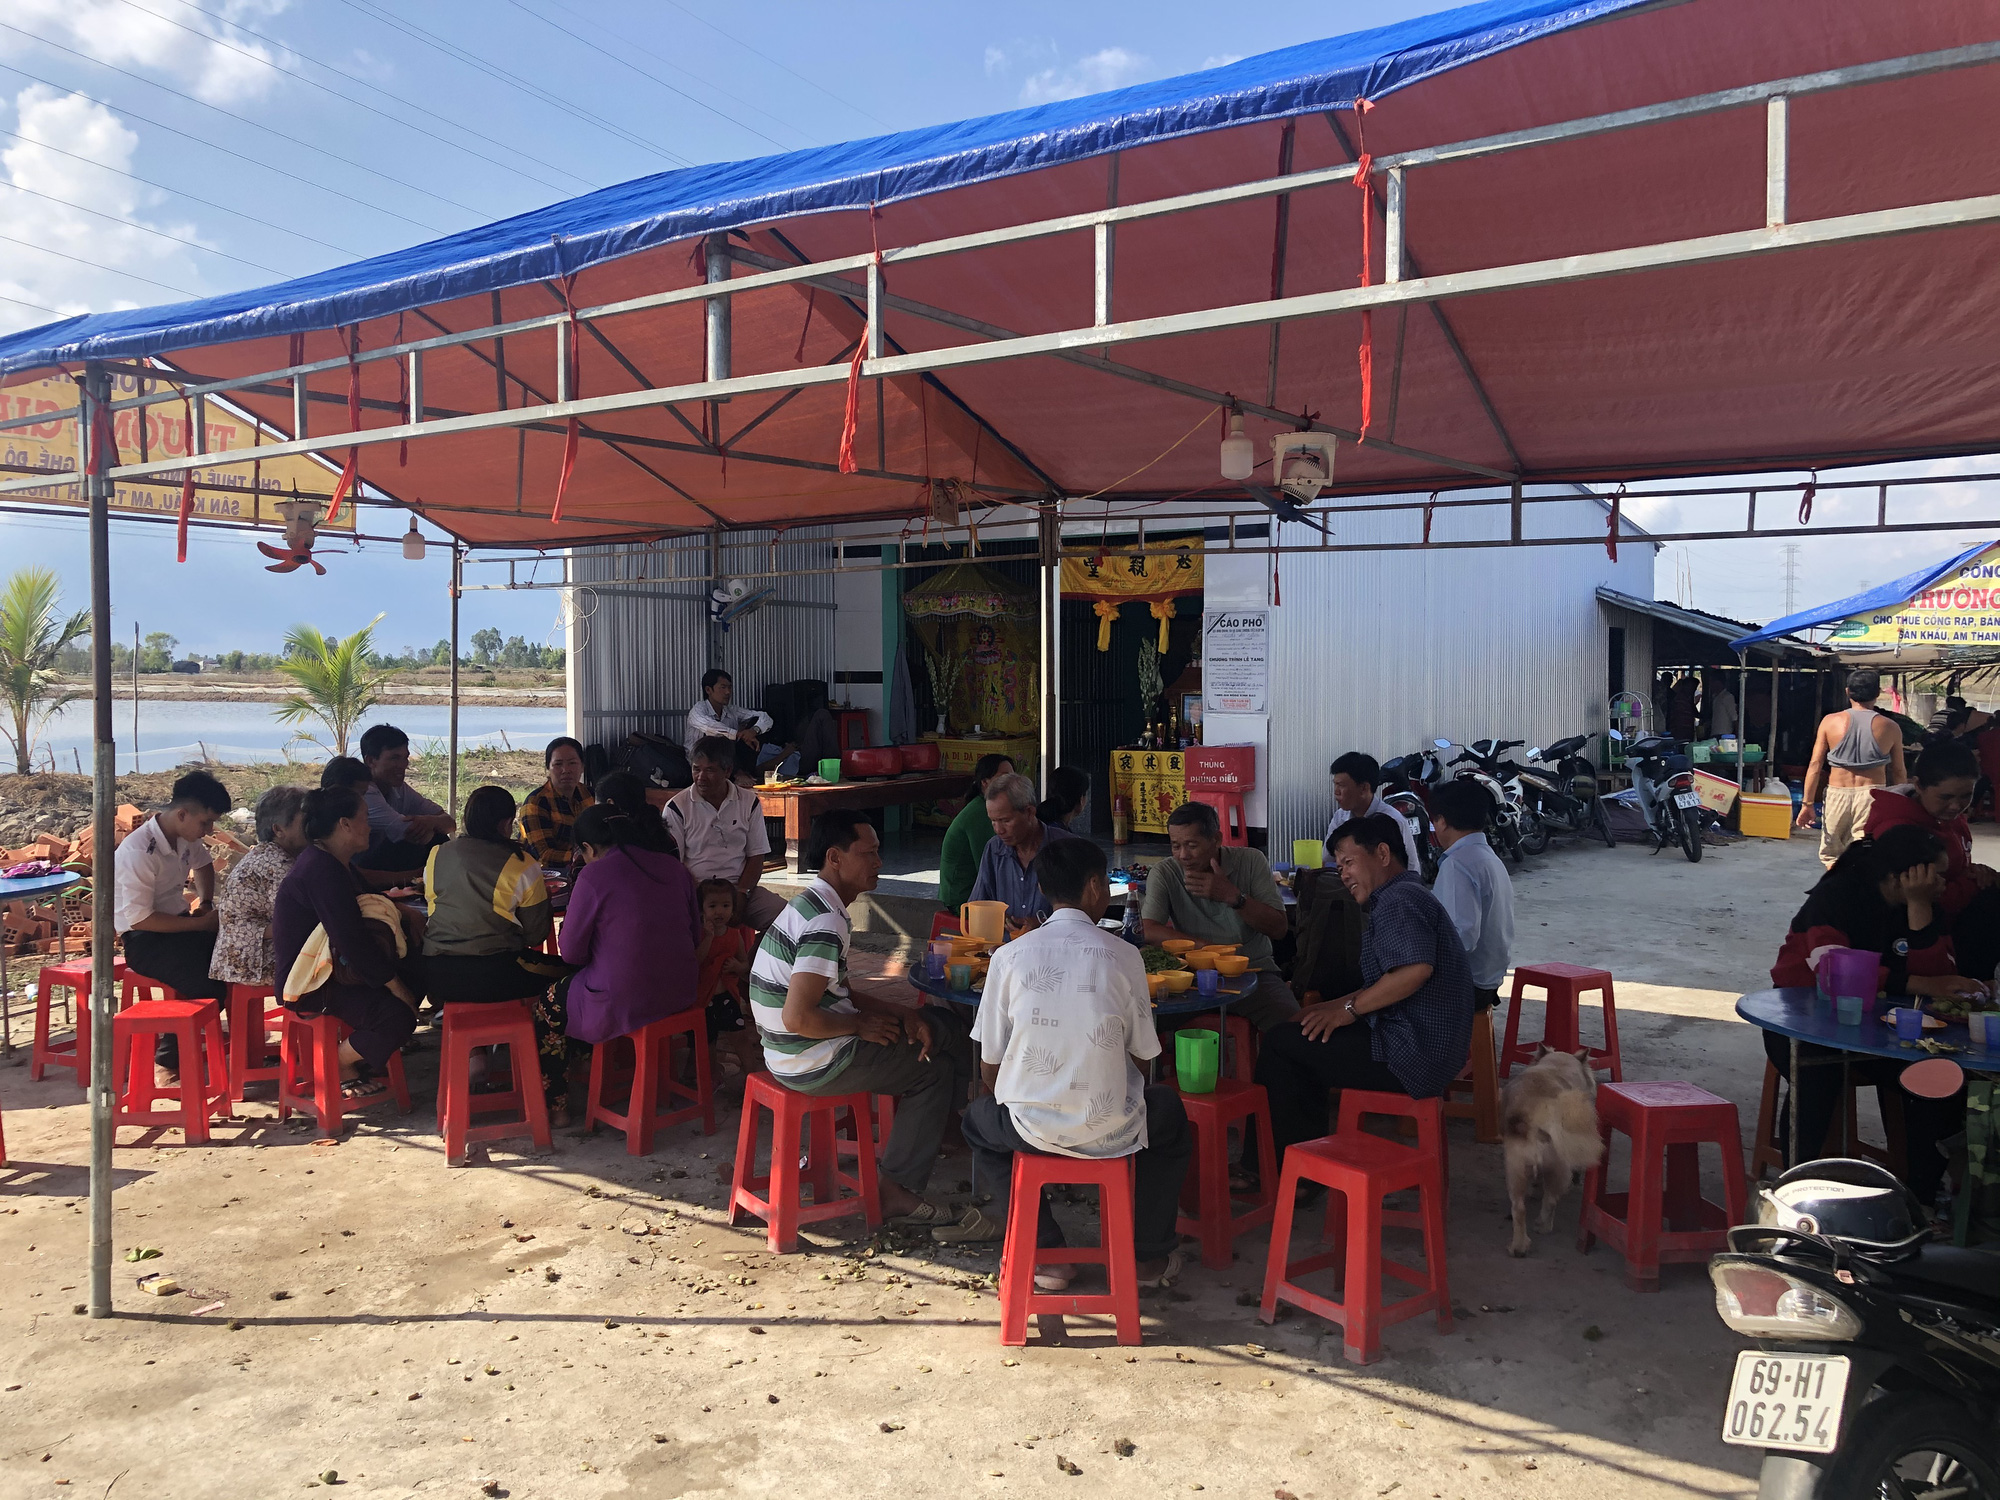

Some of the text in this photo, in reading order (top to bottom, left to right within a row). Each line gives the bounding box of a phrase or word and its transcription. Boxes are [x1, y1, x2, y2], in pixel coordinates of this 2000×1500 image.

[1219, 617, 1239, 628] CÁO
[1873, 615, 1893, 625] CHO
[1971, 631, 2000, 642] THAN
[1199, 758, 1225, 769] THÙNG
[1190, 772, 1217, 783] PHÚNG
[1731, 1400, 1831, 1445] 062.54
